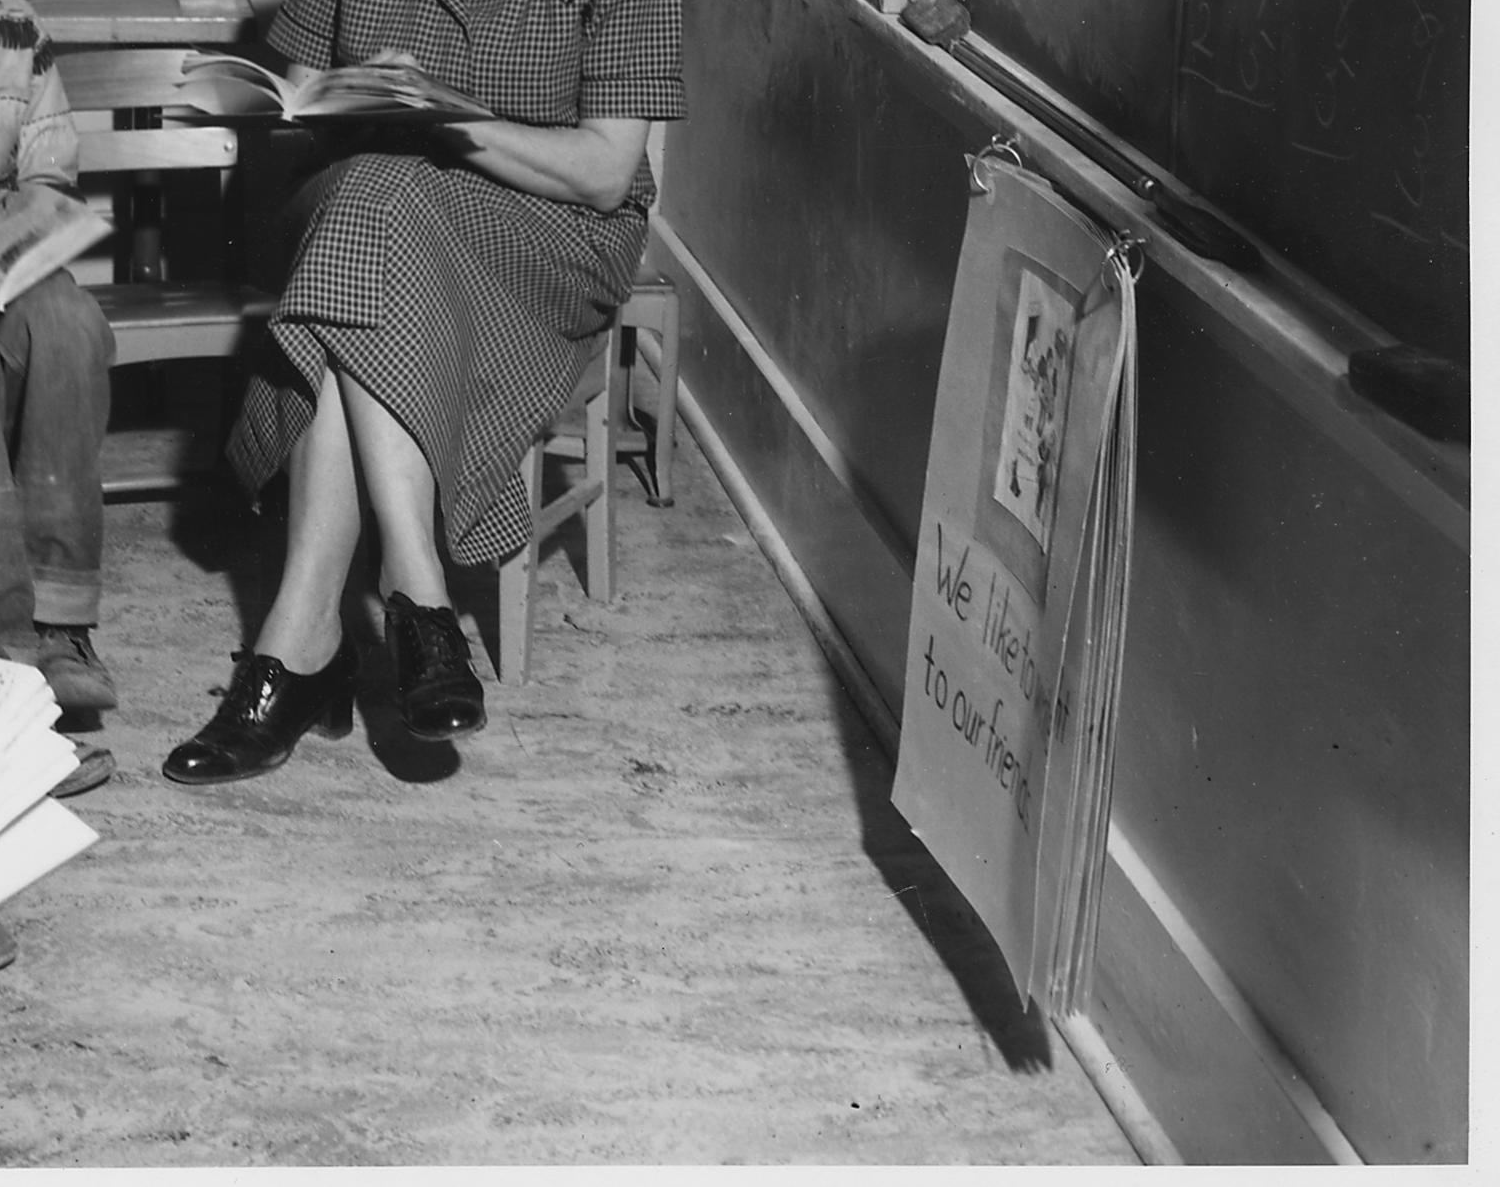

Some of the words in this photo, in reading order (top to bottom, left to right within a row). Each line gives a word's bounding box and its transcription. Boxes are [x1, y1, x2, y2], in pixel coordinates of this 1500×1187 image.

[937, 522, 972, 621] We
[983, 572, 1020, 677] like
[924, 633, 948, 710] to
[952, 690, 985, 748] our
